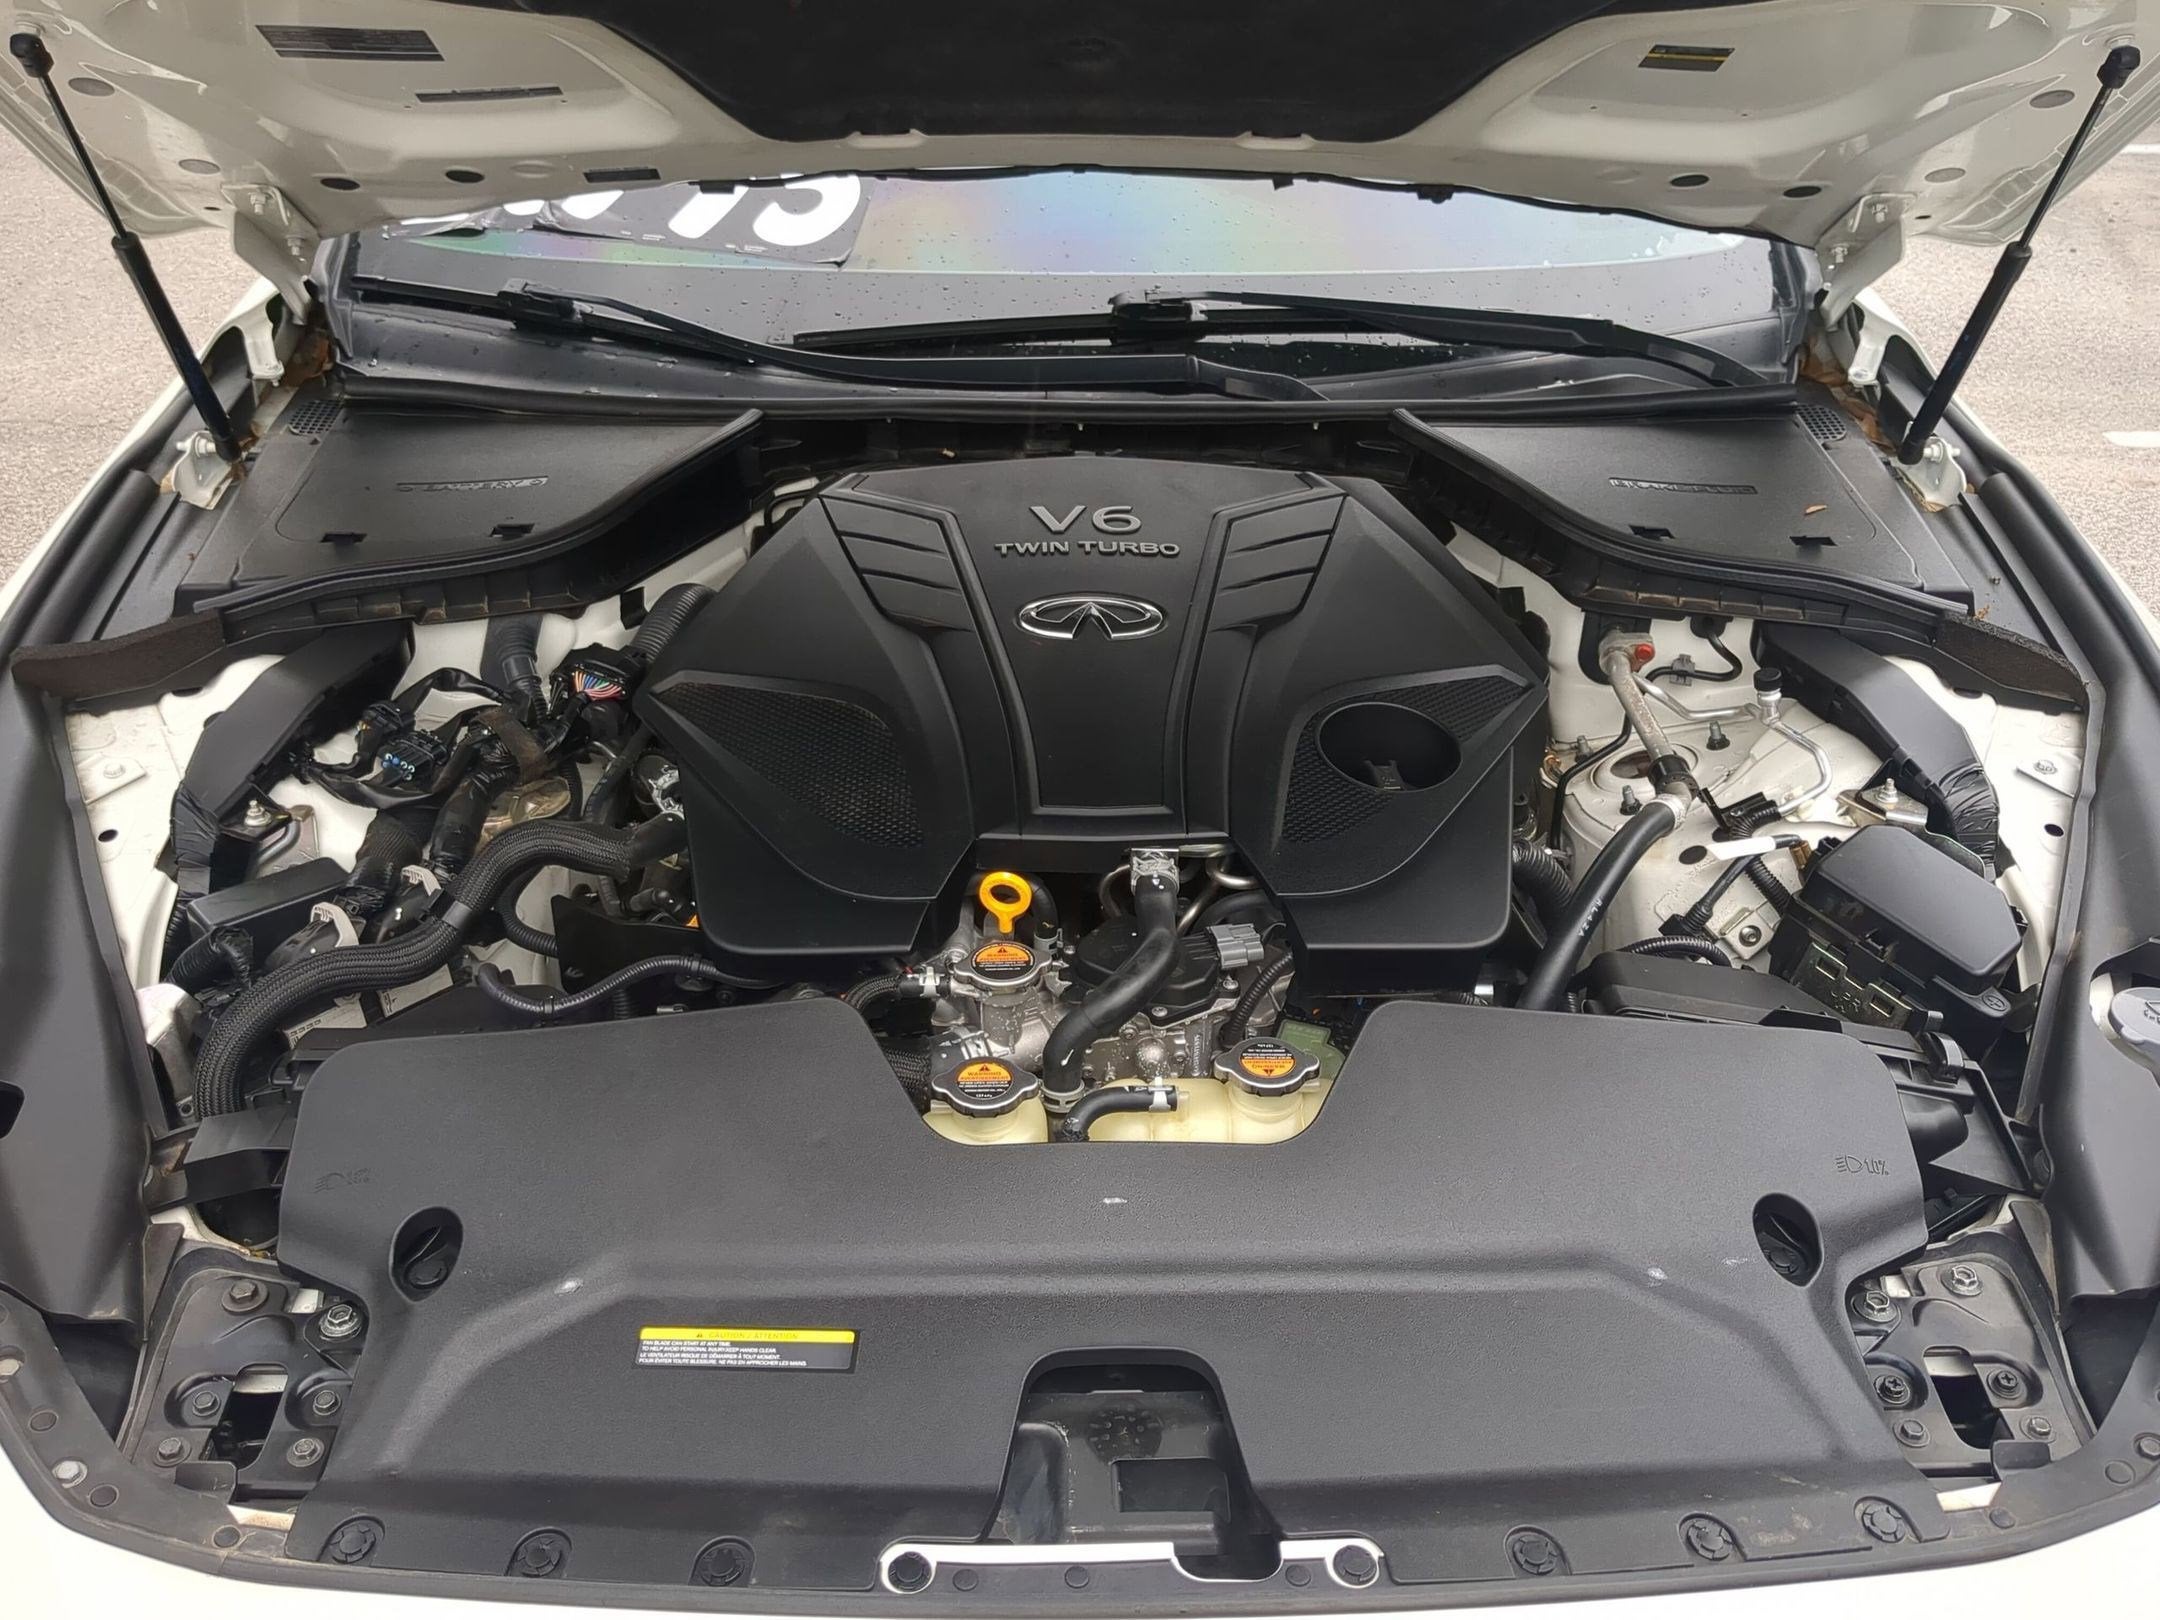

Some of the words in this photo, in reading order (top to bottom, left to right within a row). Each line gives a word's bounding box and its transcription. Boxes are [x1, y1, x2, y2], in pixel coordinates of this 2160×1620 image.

[1029, 505, 1142, 534] V6
[995, 541, 1070, 557] TWIN
[1077, 541, 1180, 557] TURBO
